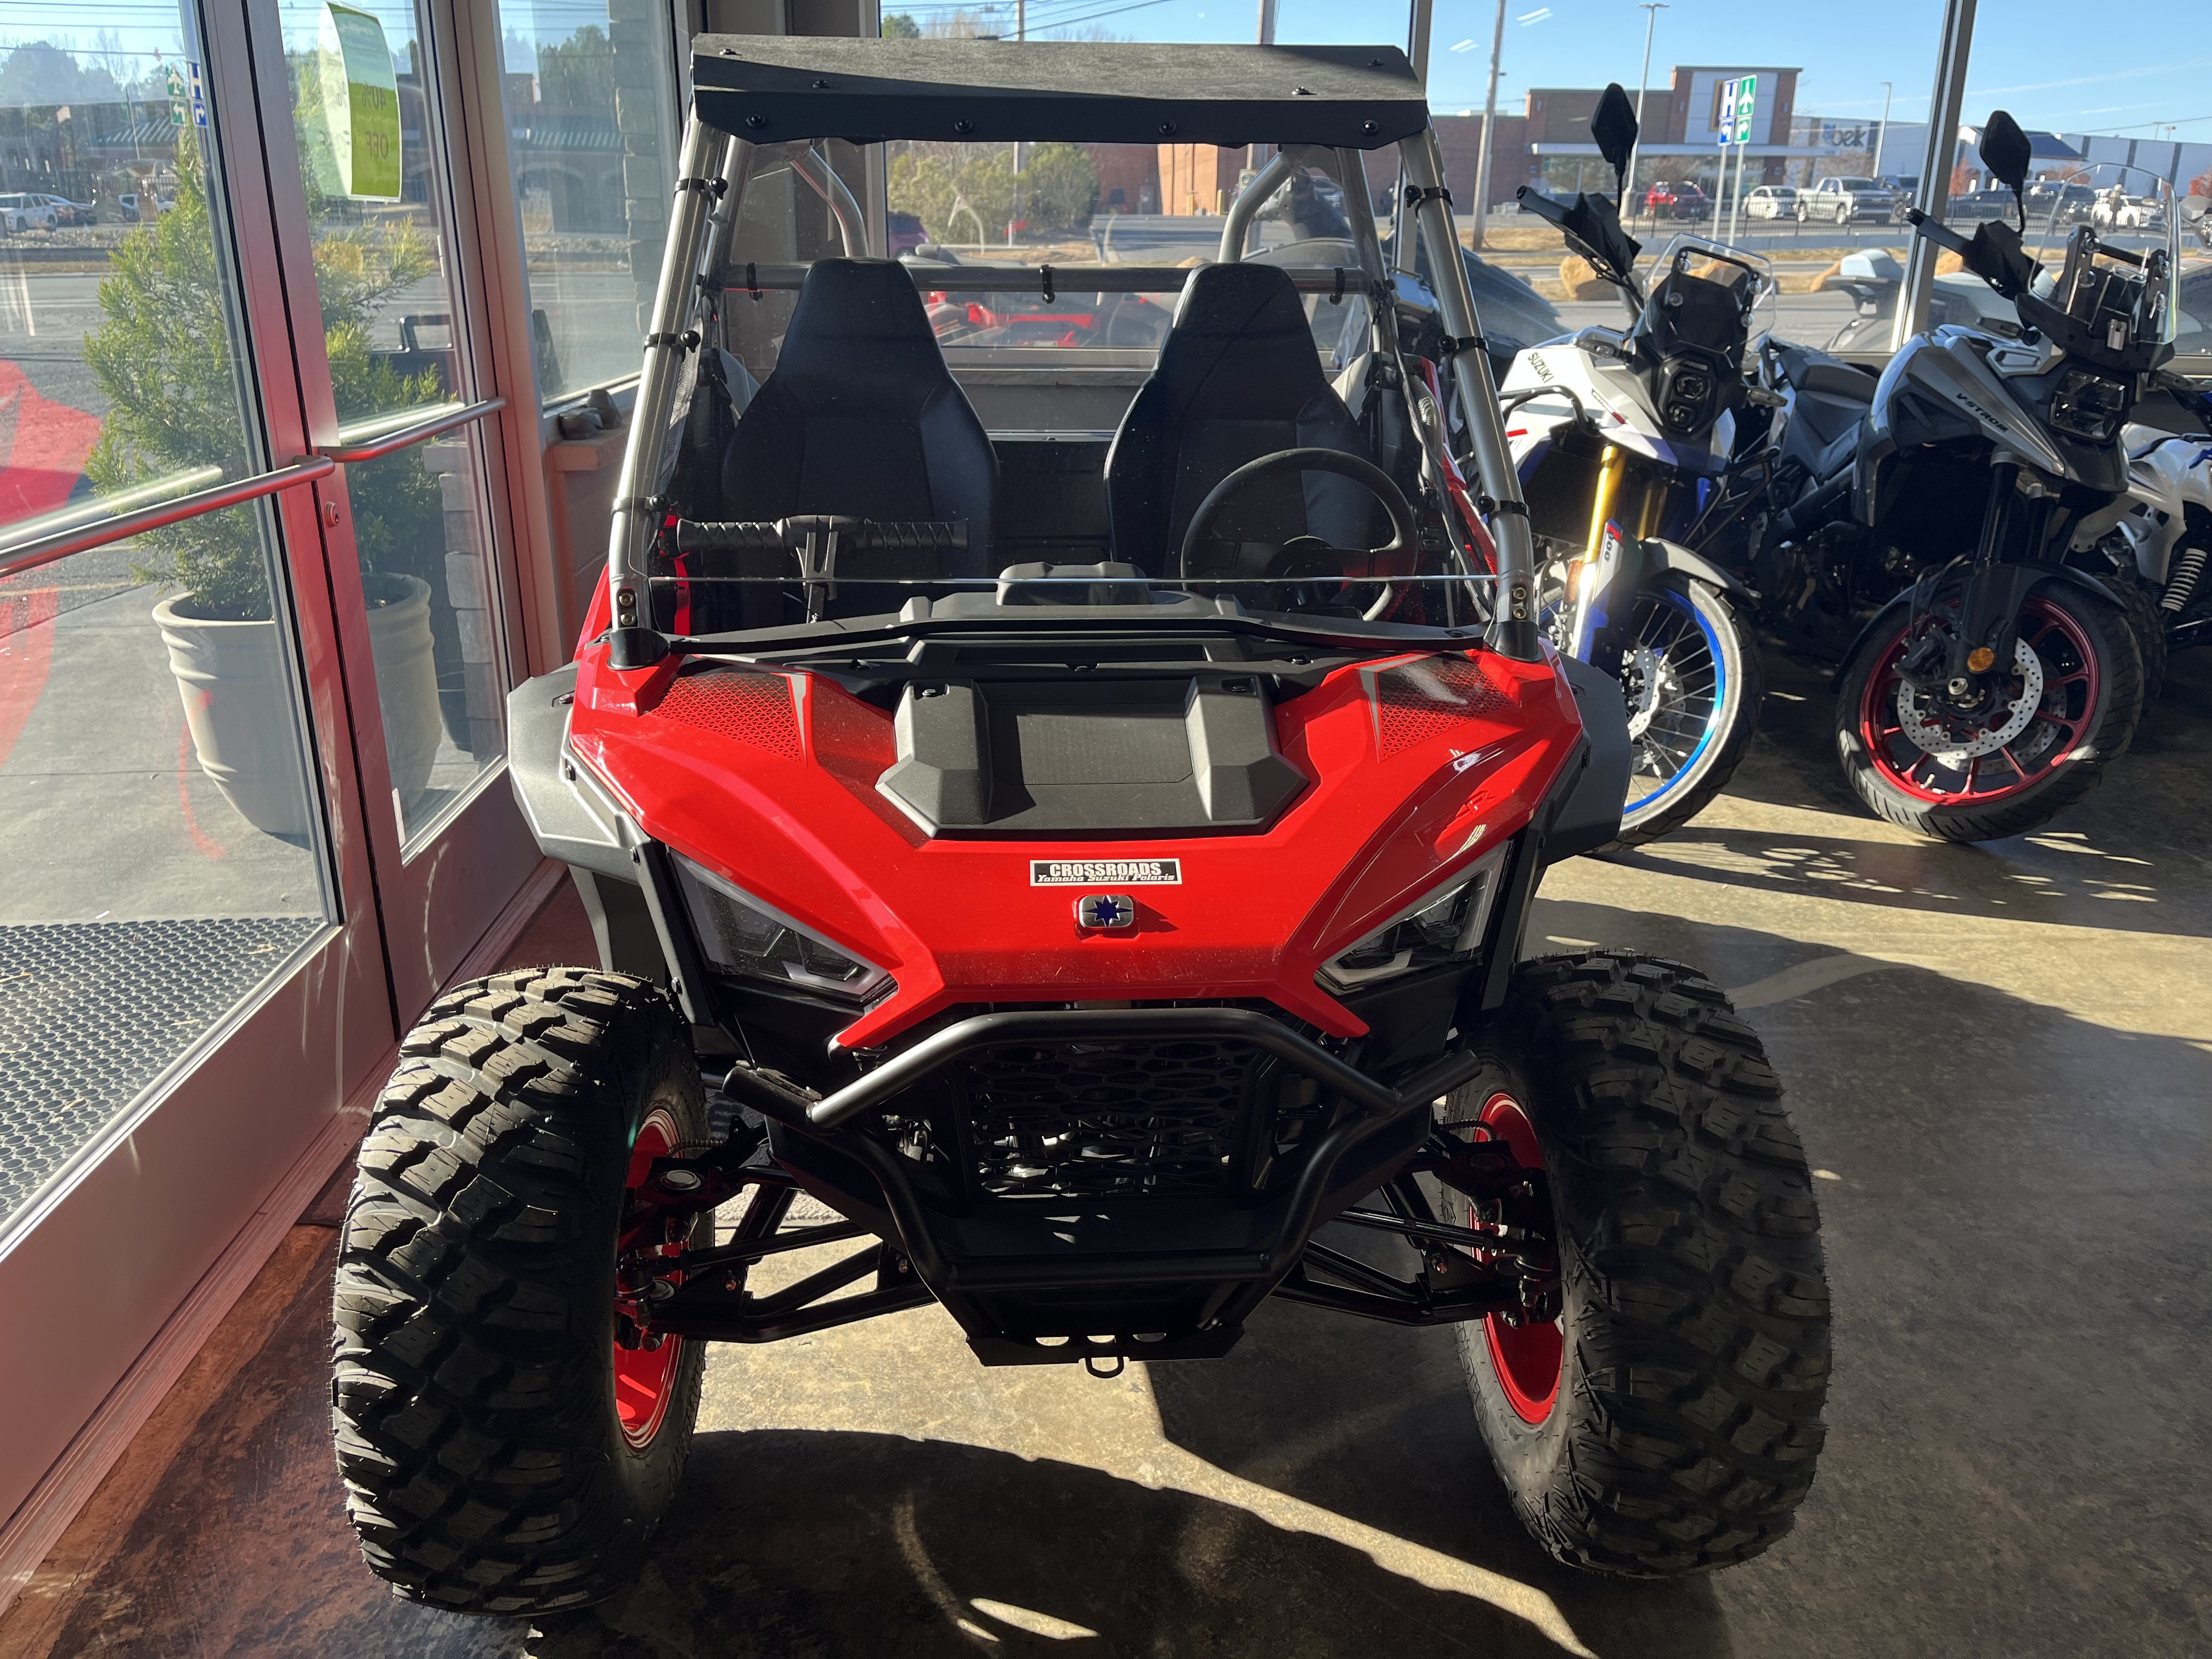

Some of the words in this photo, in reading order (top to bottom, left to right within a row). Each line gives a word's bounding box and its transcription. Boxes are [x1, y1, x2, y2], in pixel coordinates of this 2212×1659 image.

[1722, 82, 1738, 117] H
[1527, 352, 1554, 383] SUZUKI
[1049, 862, 1161, 877] CROSSROADS
[1087, 873, 1130, 882] Suzuki
[1131, 873, 1175, 881] Polaris
